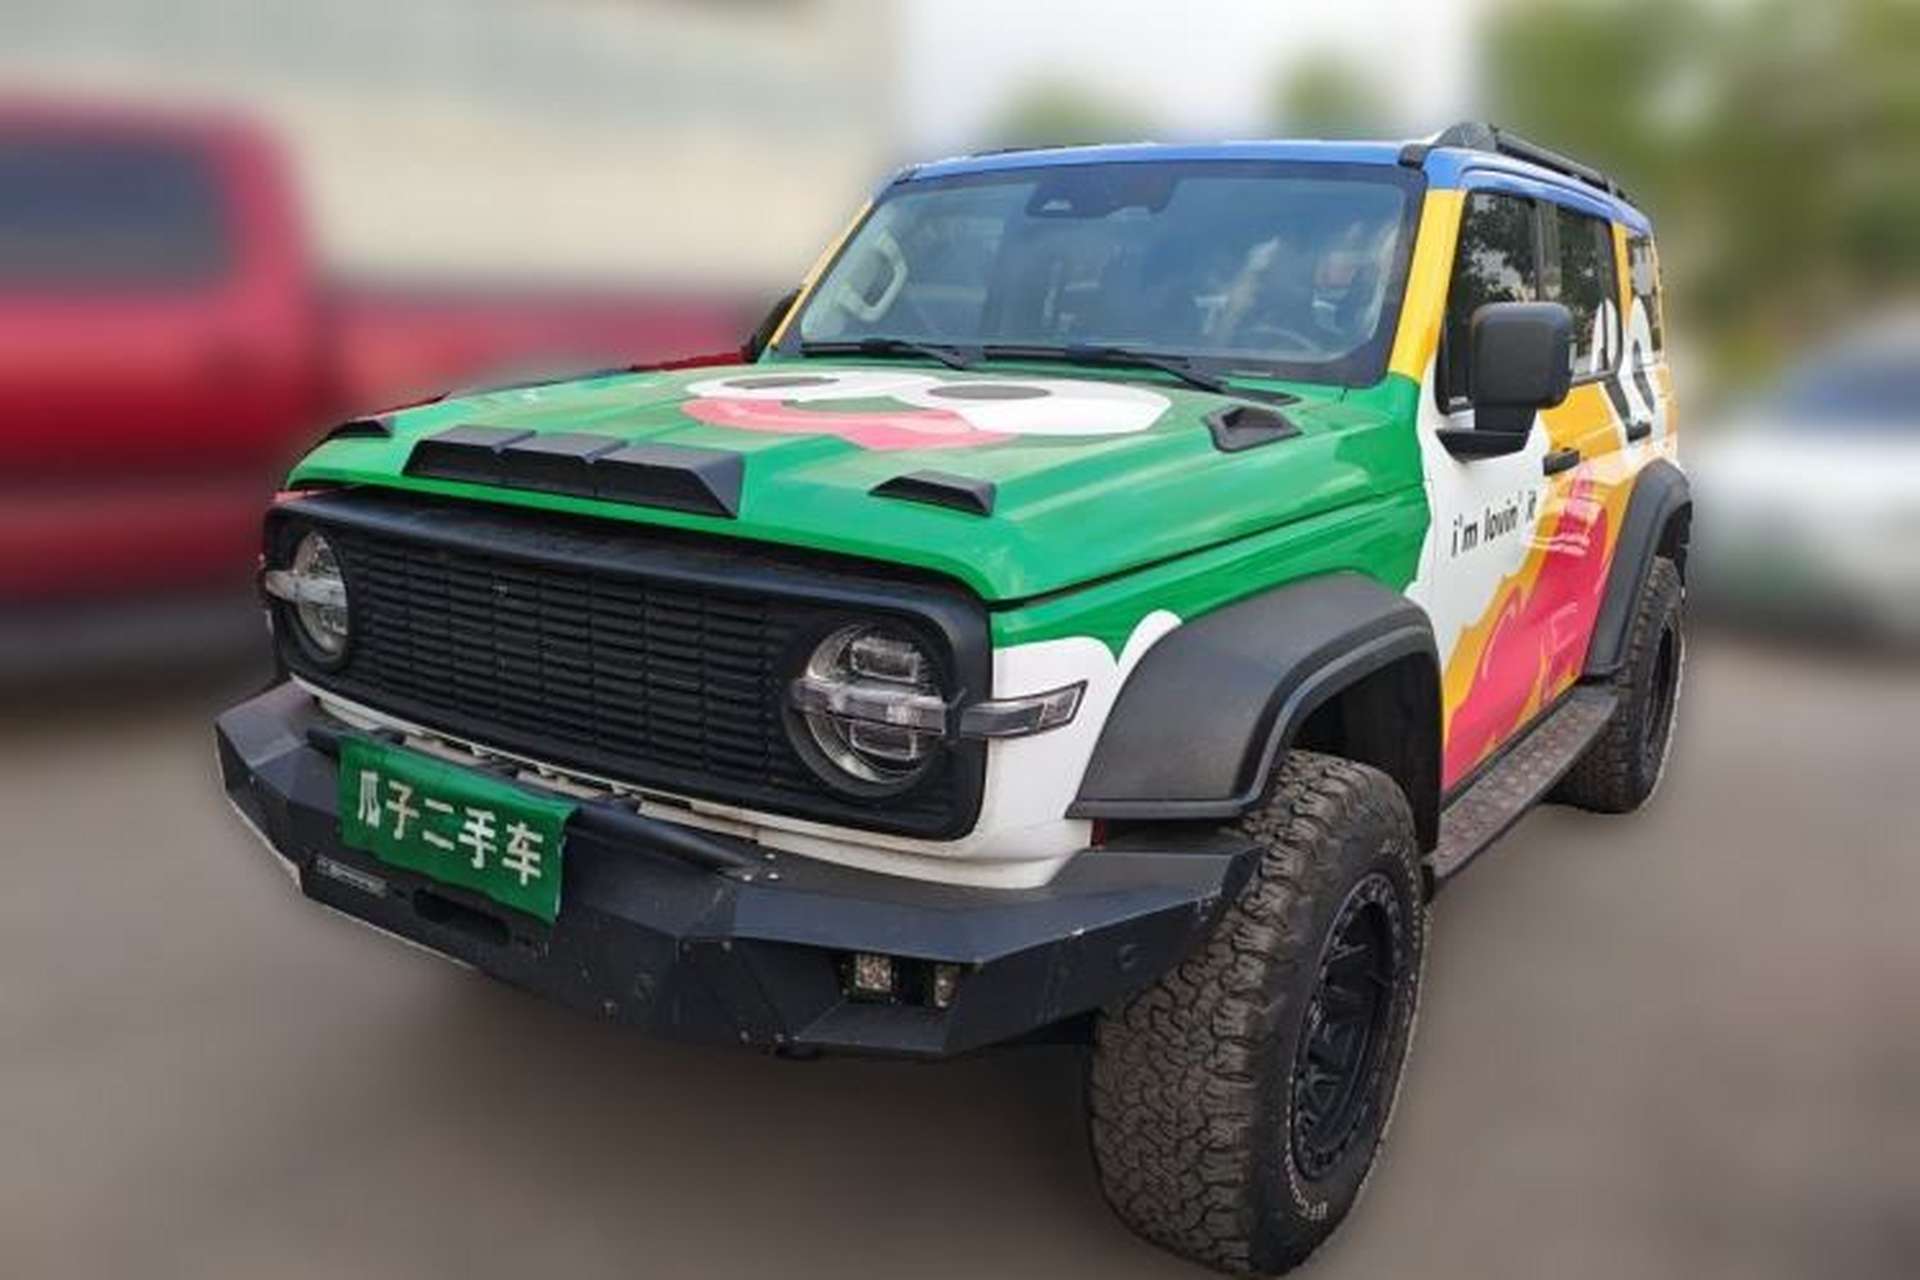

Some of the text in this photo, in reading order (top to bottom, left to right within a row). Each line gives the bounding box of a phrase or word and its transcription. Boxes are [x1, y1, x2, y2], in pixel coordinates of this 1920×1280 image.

[1451, 513, 1478, 558] i'm
[357, 769, 544, 886] 瓜子二手车
